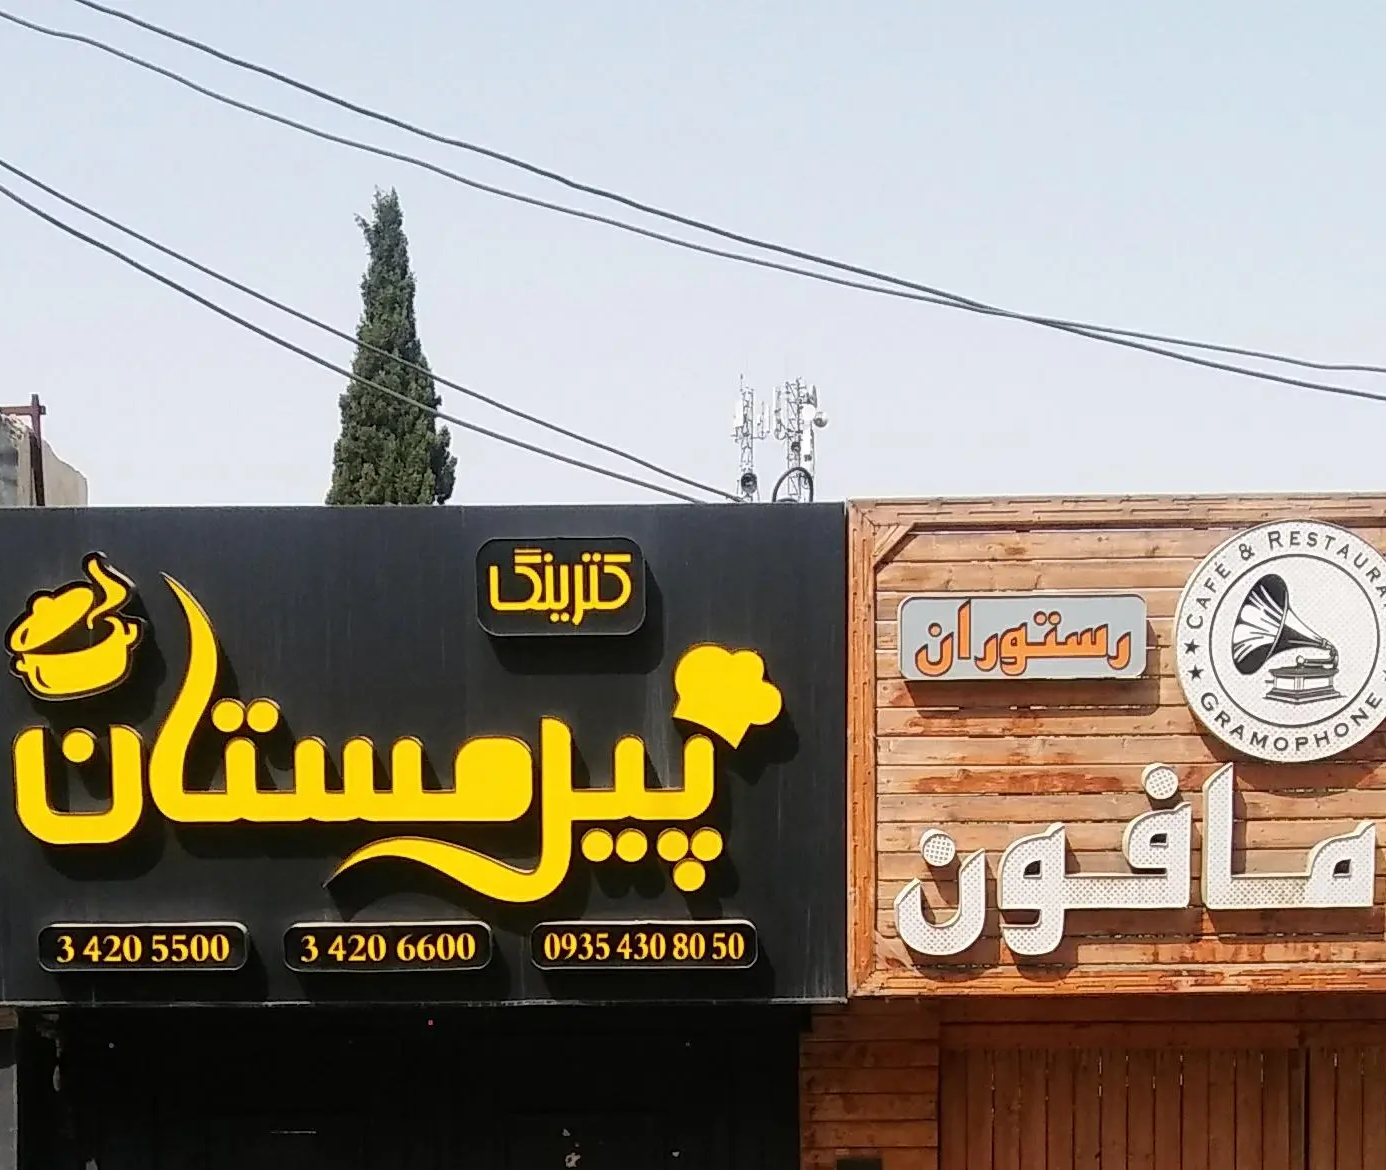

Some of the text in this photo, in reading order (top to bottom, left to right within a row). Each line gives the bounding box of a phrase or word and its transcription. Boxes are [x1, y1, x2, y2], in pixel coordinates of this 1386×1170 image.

[1237, 542, 1256, 562] &
[488, 547, 633, 626] کترینگ
[914, 599, 1132, 678] رستوران
[1199, 691, 1384, 752] GRAMOPHONE
[57, 933, 231, 963] 3 420 5500
[301, 932, 476, 962] 3 420 6600
[543, 931, 745, 960] 0935 430 80 50
